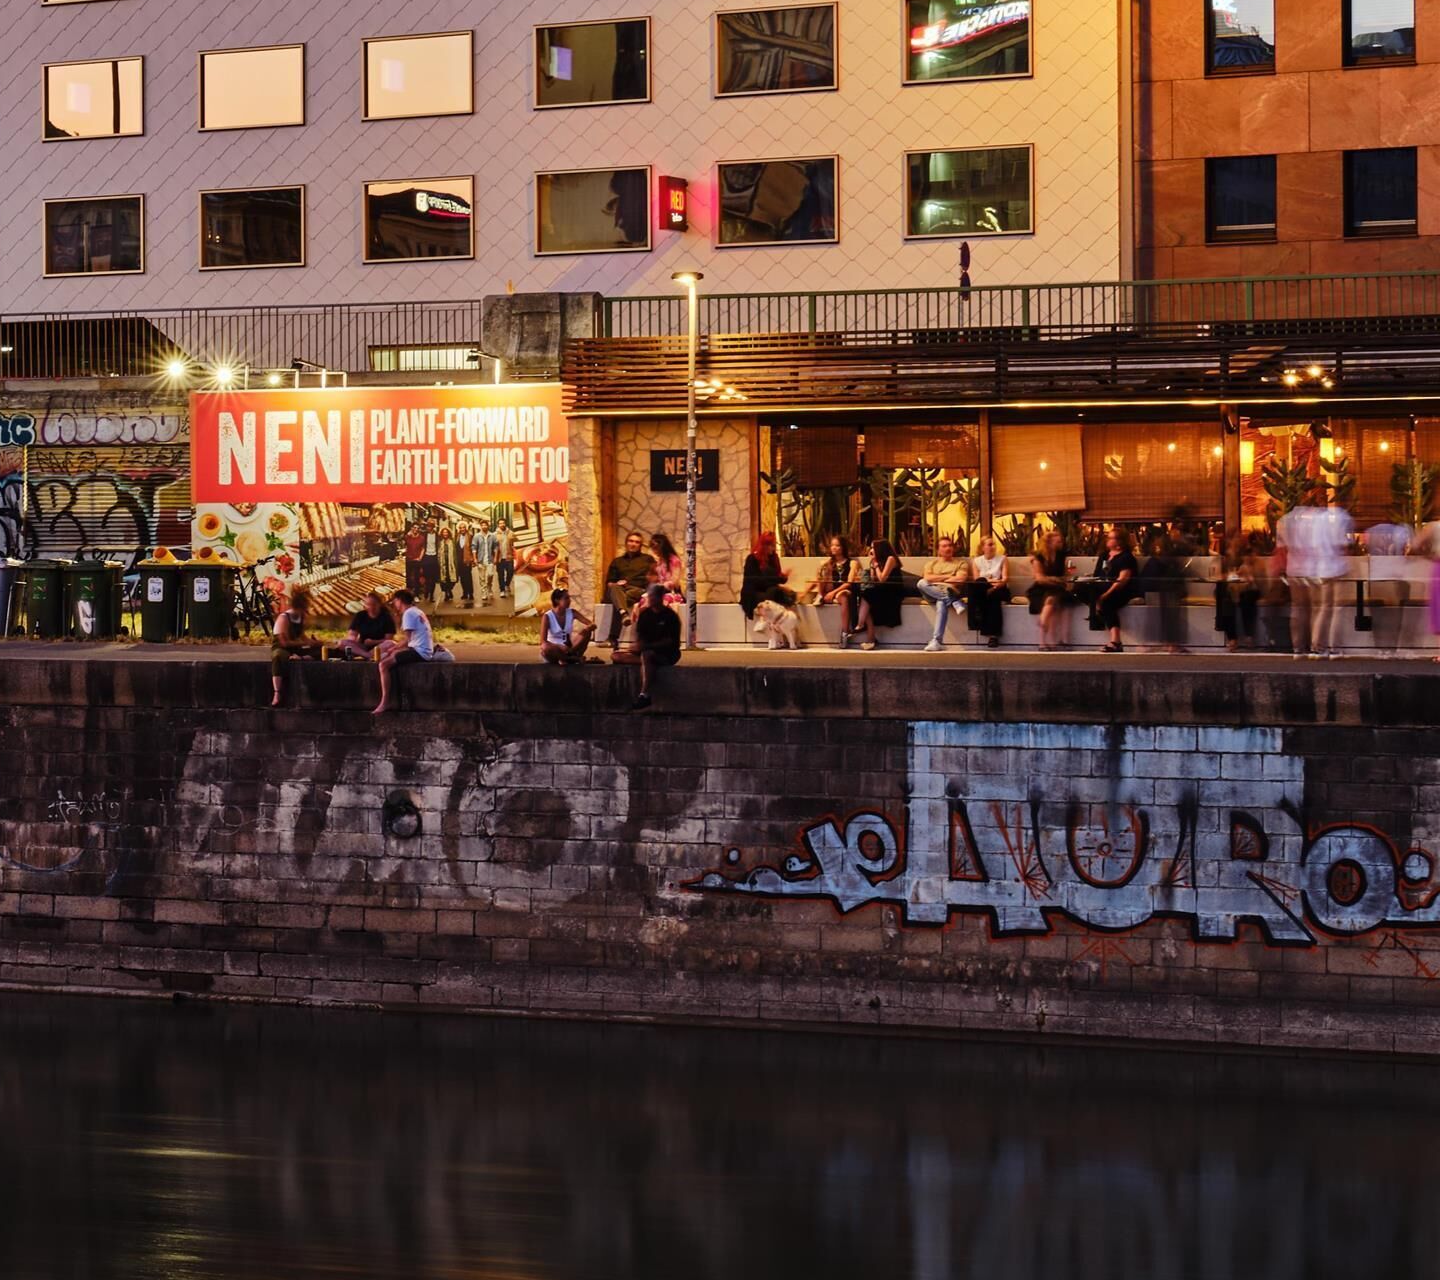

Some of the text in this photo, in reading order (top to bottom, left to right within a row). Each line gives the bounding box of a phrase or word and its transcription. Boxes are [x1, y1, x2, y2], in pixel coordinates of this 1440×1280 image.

[670, 189, 684, 211] RED
[371, 406, 550, 445] PLANT-FORWARD
[218, 409, 365, 485] NENI
[371, 448, 525, 485] EARTH-LOVING
[665, 457, 703, 475] NEI
